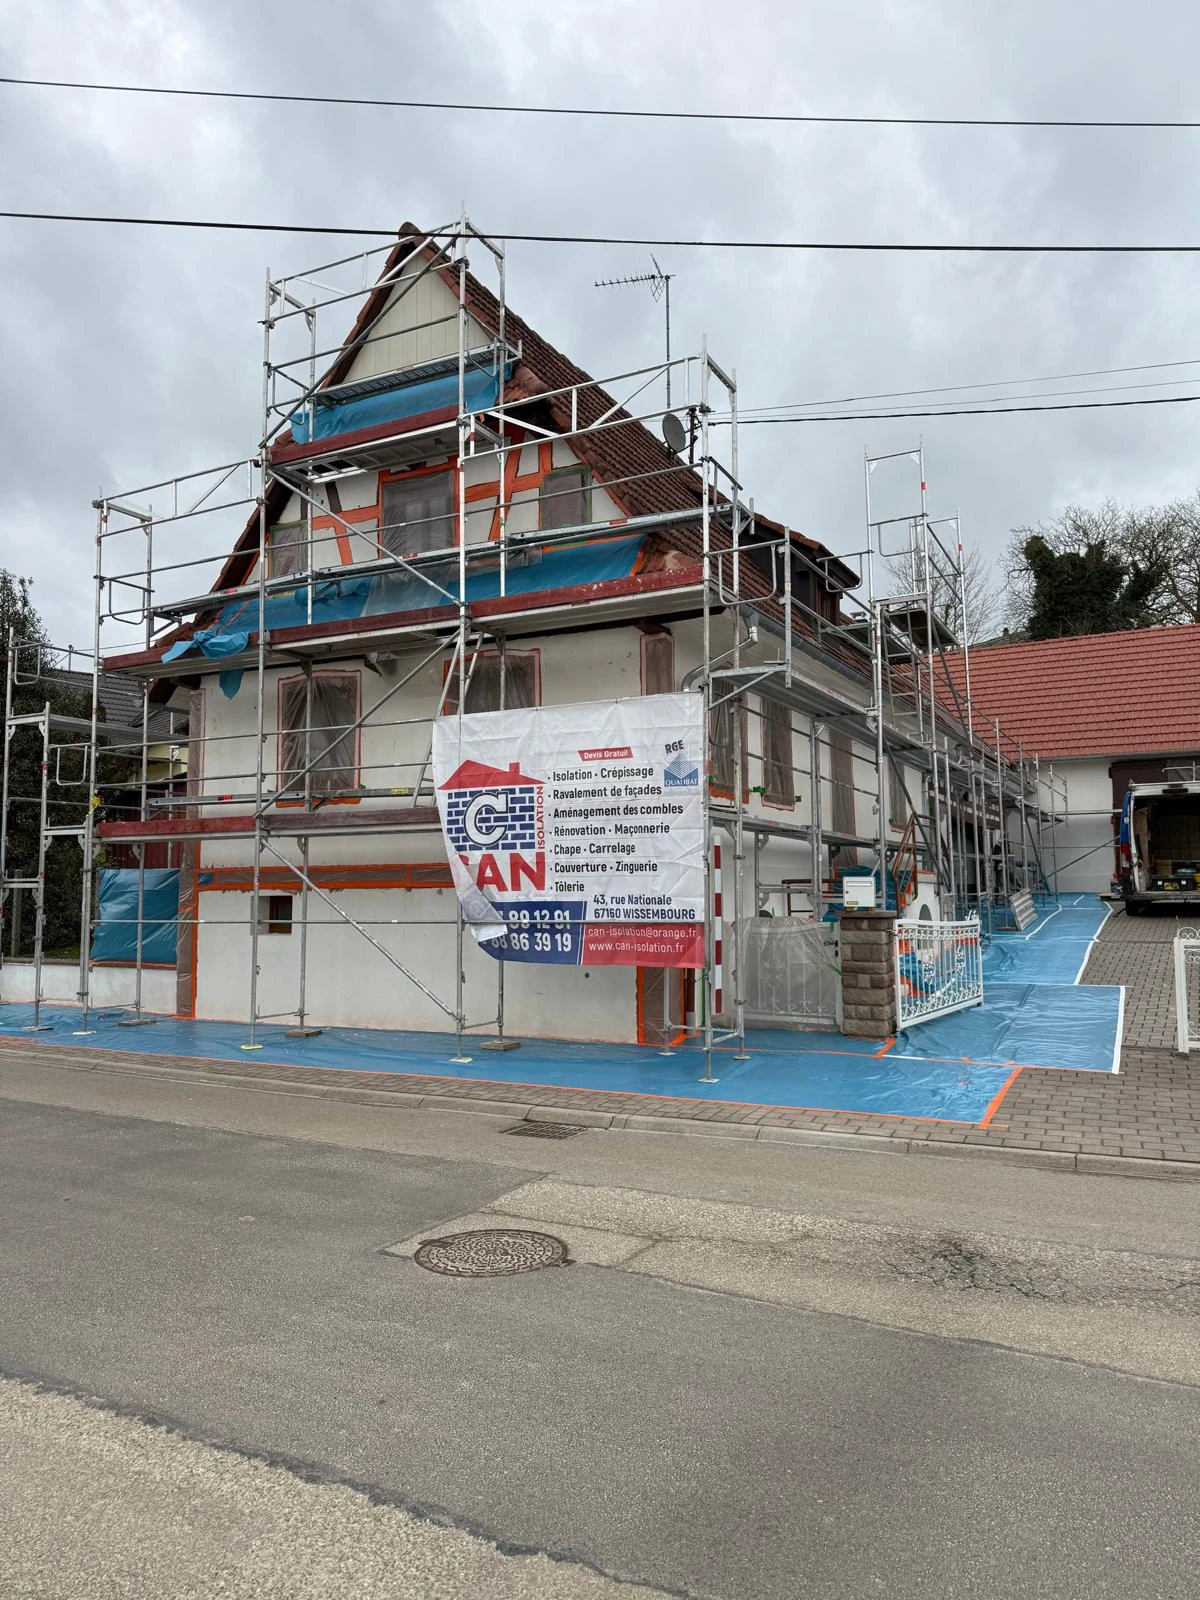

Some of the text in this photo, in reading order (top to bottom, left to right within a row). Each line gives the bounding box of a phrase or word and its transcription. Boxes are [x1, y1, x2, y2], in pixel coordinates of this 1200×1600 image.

[604, 750, 628, 758] Gratuit
[665, 740, 684, 754] RGE
[553, 766, 653, 781] Isolation Crépissage
[553, 784, 662, 800] Ravalement de façades
[536, 786, 545, 849] ISOLATION
[553, 802, 683, 820] Aménagement des combles
[554, 822, 670, 837] Rénovation Maçonnerie
[554, 842, 636, 857] Chape Carrelage
[459, 852, 545, 892] AN
[554, 860, 658, 874] Couverture Zinguerie
[554, 881, 585, 892] Tôlerie
[593, 894, 672, 906] 43, rue Nationale
[533, 910, 551, 929] 12
[594, 908, 696, 920] 67160 WISSEMBOURG
[588, 926, 697, 940] can-isolation@orange.fr
[510, 932, 530, 951] 86
[533, 932, 551, 952] 39
[555, 932, 572, 952] 19
[588, 942, 685, 953] www.can-isolation.fr
